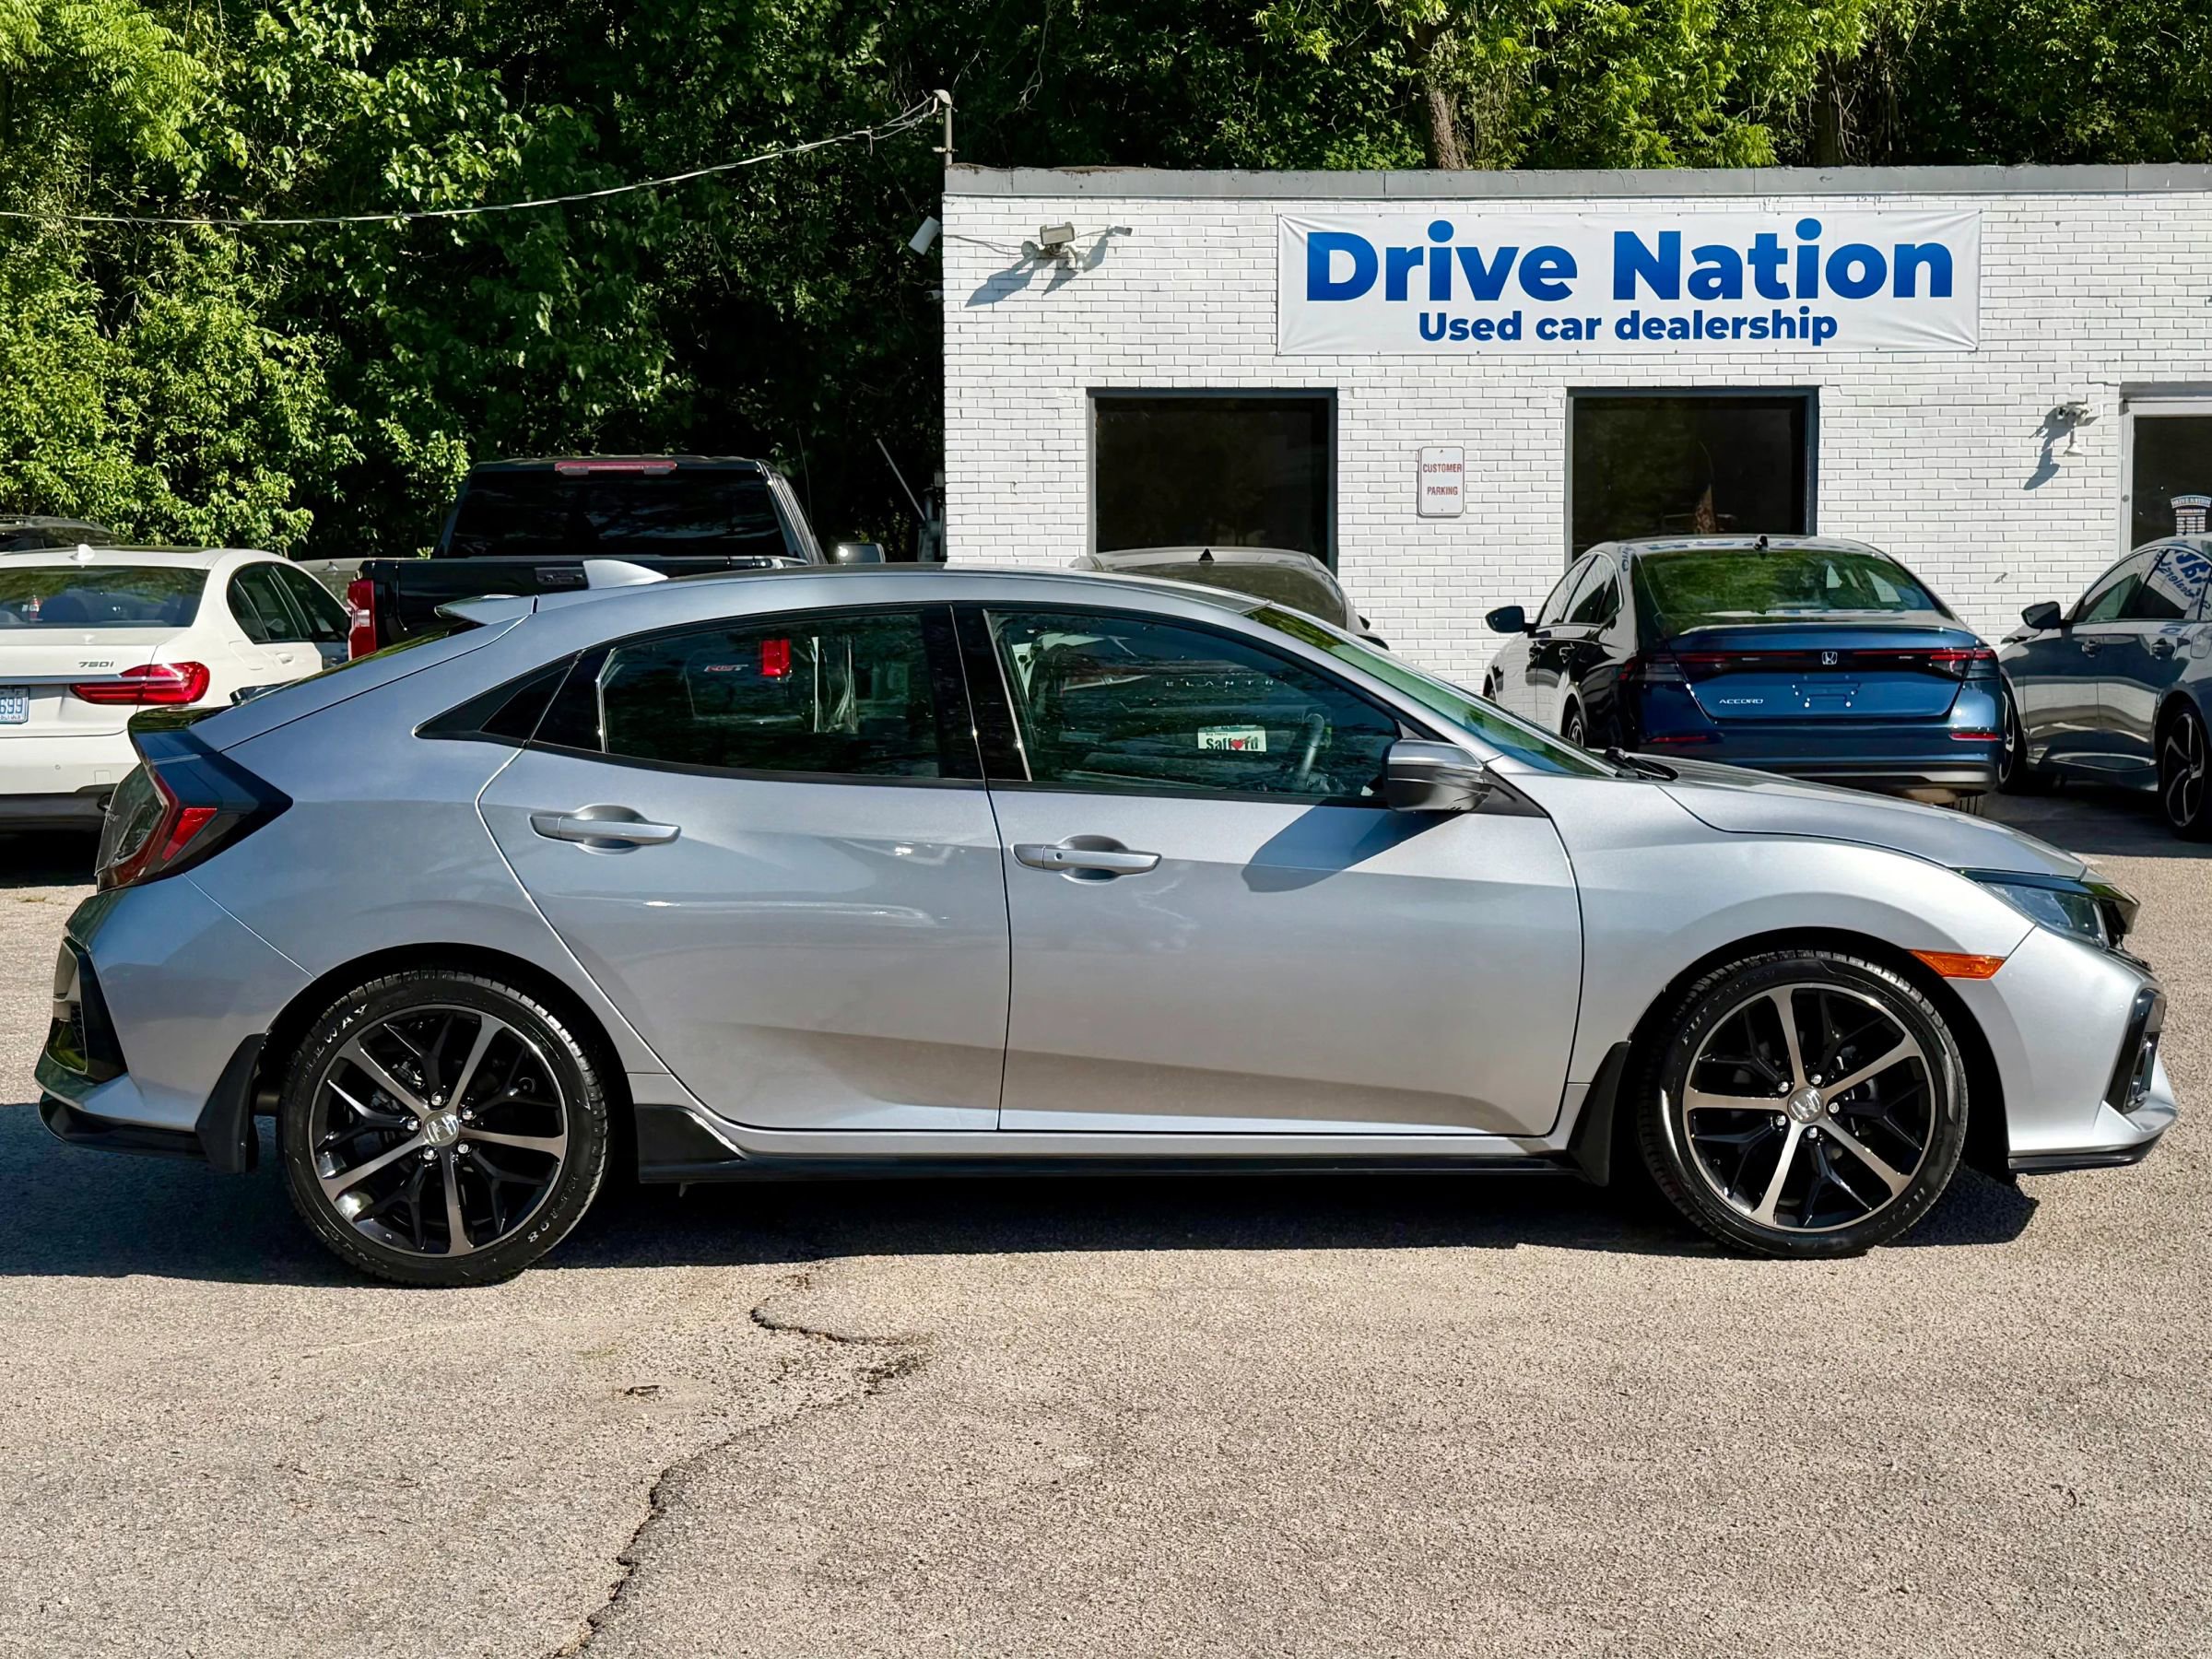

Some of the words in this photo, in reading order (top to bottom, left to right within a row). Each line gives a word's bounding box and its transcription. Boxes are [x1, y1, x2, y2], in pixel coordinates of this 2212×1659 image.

[1307, 220, 1577, 301] Drive
[1613, 218, 1953, 300] Nation
[1419, 311, 1522, 341] Used
[1535, 318, 1602, 341] car
[1614, 306, 1838, 346] dealership
[1422, 464, 1462, 473] CUSTOMER
[1427, 486, 1458, 496] PARKING
[0, 696, 23, 714] 699
[1205, 736, 1260, 751] Saffrd
